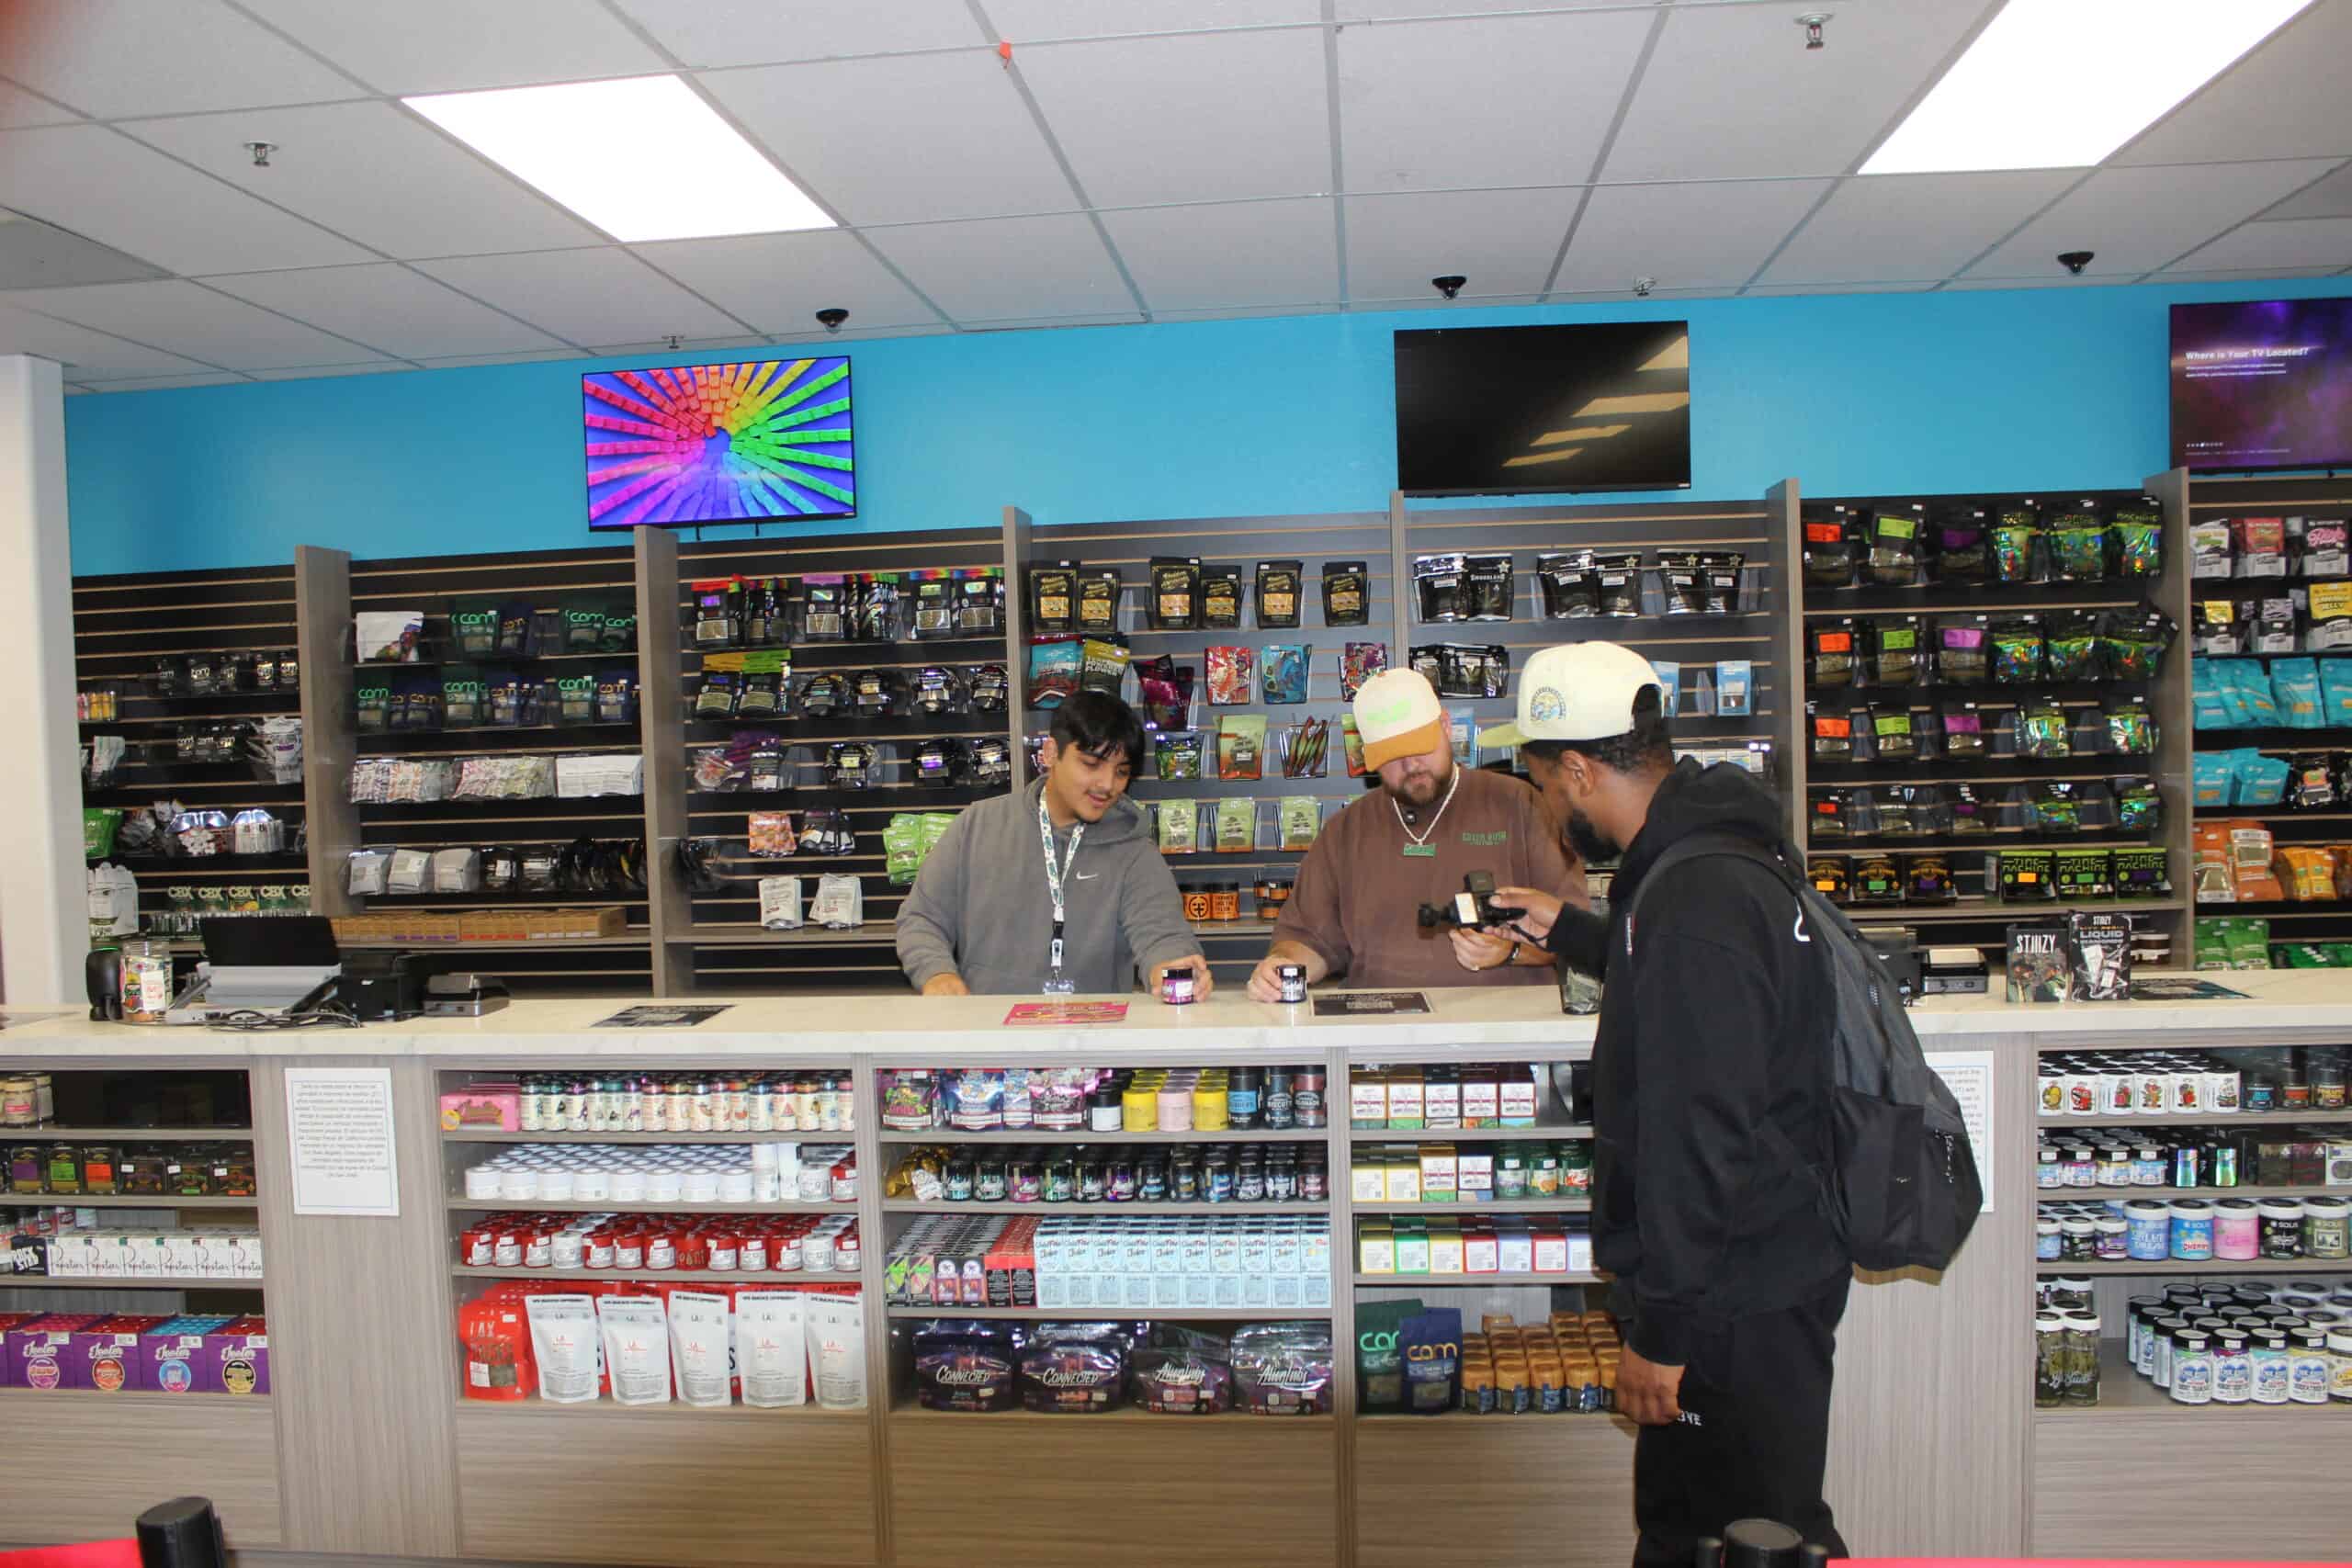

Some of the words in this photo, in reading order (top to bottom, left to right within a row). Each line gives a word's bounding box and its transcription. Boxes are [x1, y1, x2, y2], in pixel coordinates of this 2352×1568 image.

[2186, 352, 2215, 361] Where
[2252, 348, 2264, 357] TV
[2266, 346, 2309, 357] Located?
[198, 886, 224, 901] CBX
[260, 885, 287, 899] CBX
[291, 885, 311, 897] CB
[2079, 930, 2124, 939] LIQUID
